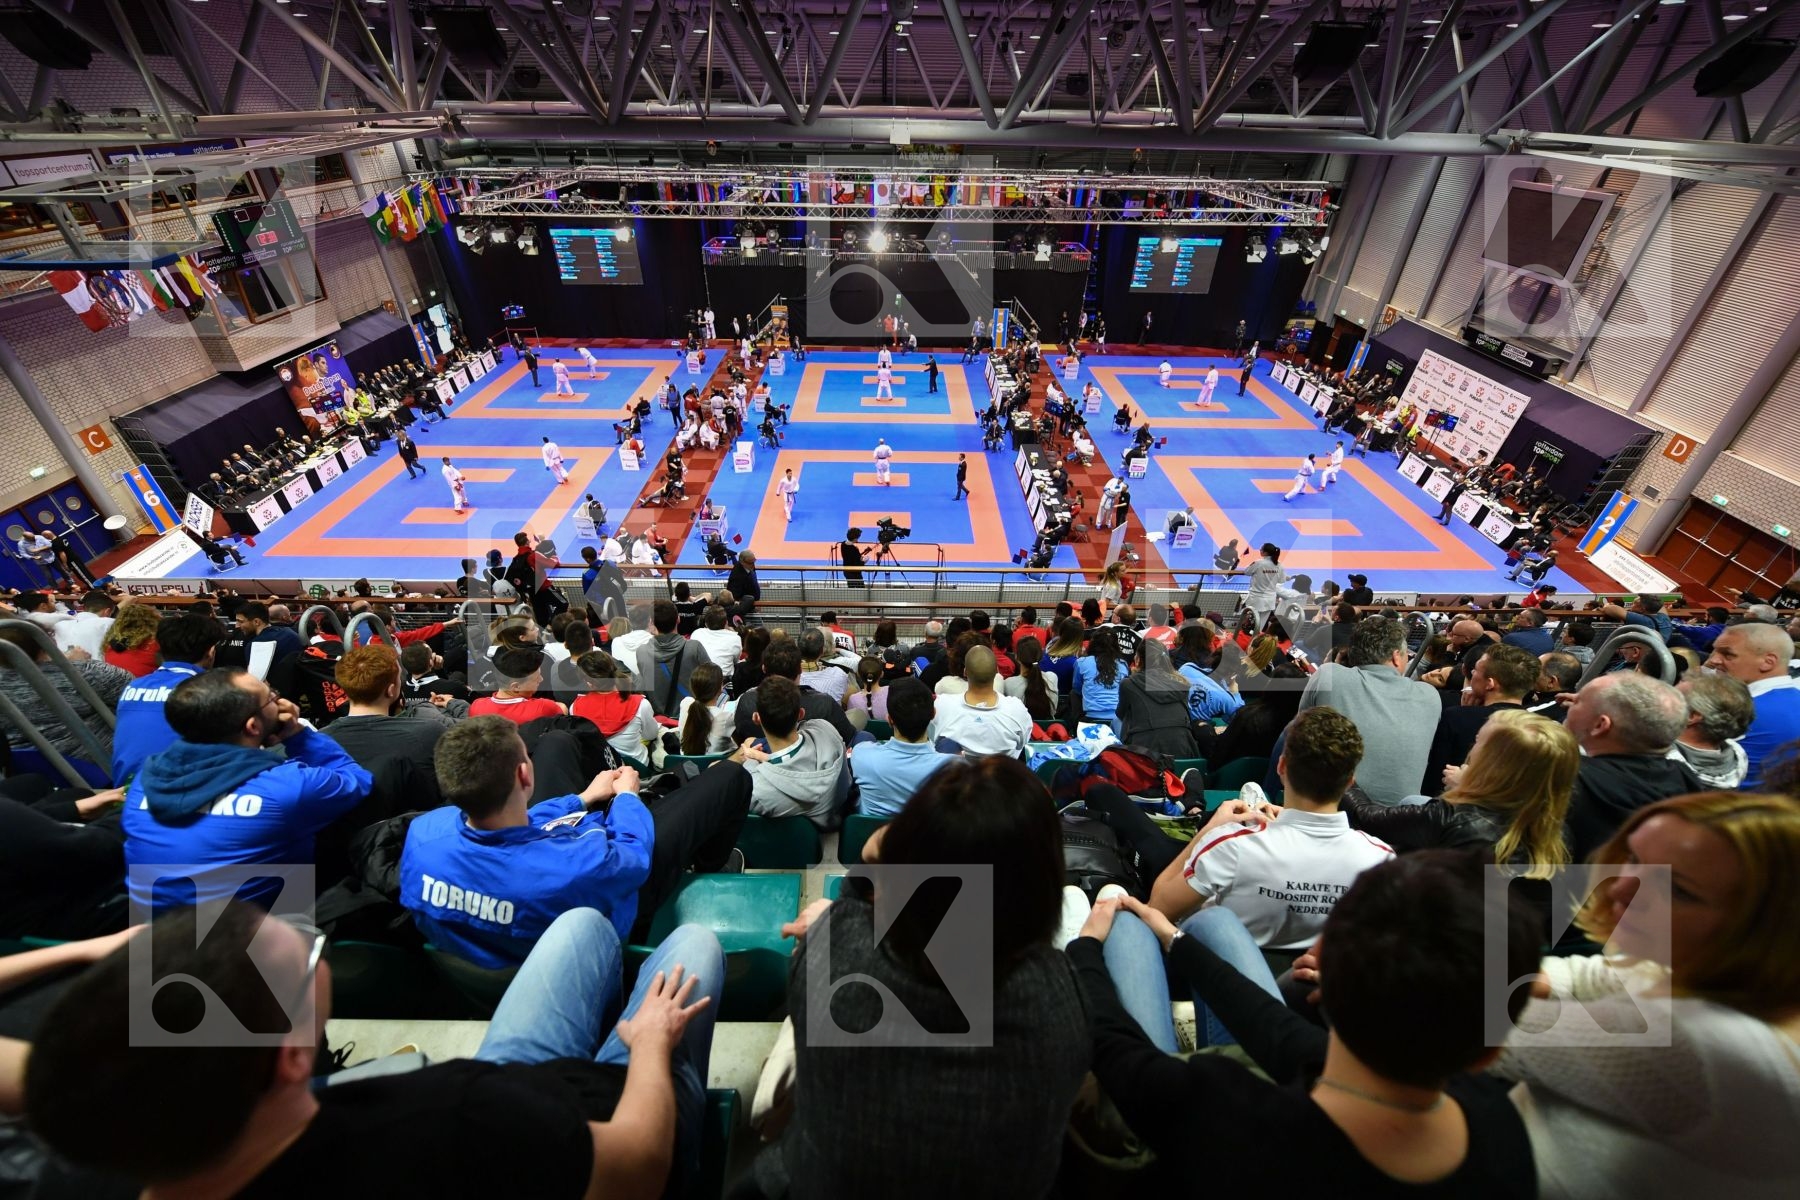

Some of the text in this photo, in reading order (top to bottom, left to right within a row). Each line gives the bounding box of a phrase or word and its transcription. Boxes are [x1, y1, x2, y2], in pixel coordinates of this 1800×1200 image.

[996, 323, 1003, 333] 3
[418, 341, 426, 351] 5
[302, 380, 325, 397] Dutch
[322, 372, 342, 387] Open
[88, 431, 104, 448] C
[1670, 439, 1688, 457] D
[1533, 446, 1560, 465] TOPSPORT
[1535, 441, 1565, 459] rotterdam
[143, 489, 161, 507] 6
[1598, 516, 1616, 534] 2
[120, 684, 171, 702] Toruk
[322, 681, 336, 712] adidas
[1258, 886, 1319, 903] FUDOSHIN
[1286, 881, 1331, 892] KARATE
[421, 874, 514, 925] TORUKO
